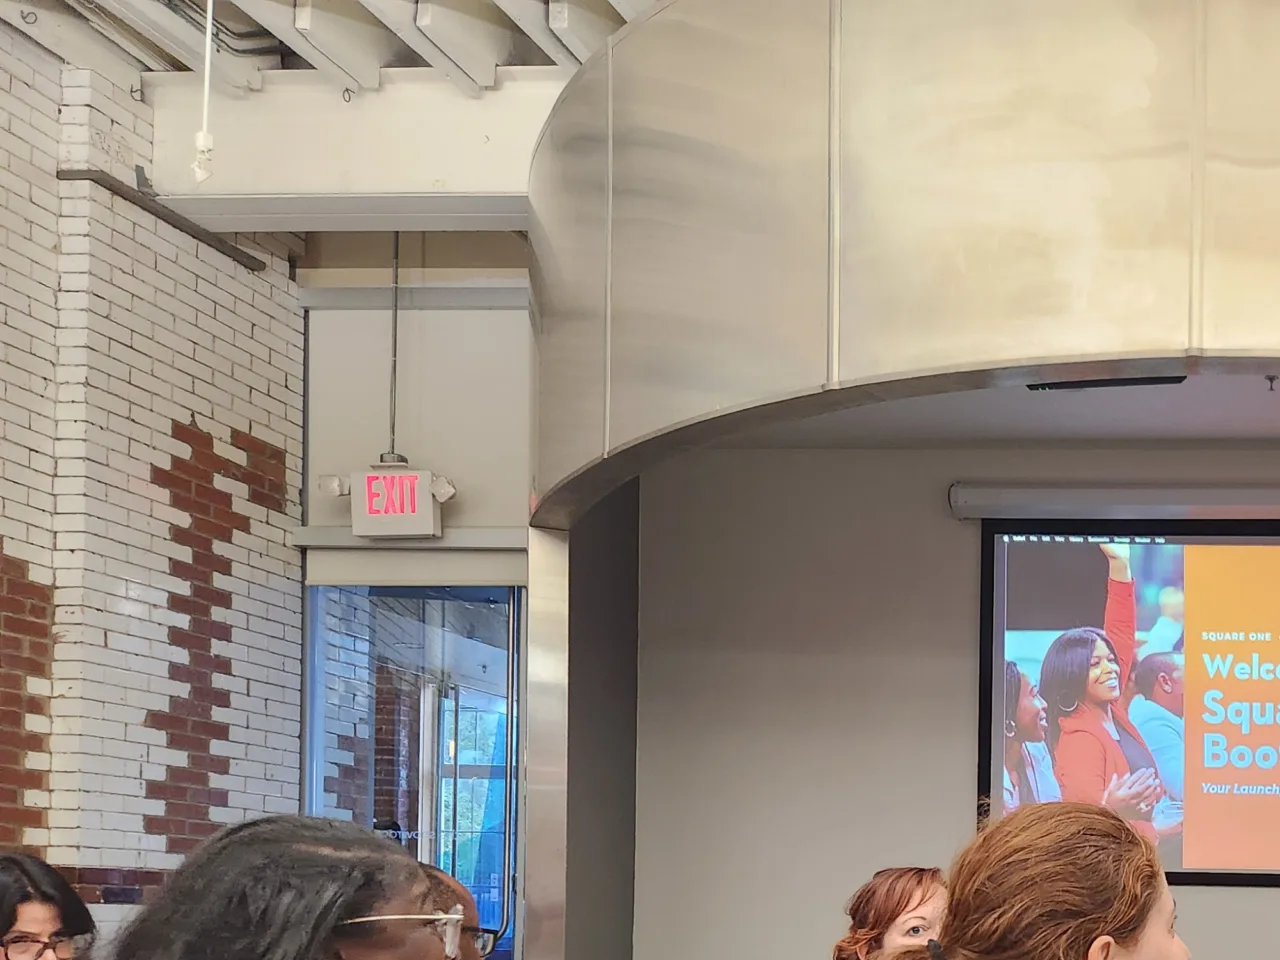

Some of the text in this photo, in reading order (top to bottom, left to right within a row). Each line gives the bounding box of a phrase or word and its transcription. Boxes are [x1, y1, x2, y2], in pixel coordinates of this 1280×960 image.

[366, 475, 418, 514] EXIT
[1201, 632, 1245, 641] SQUARE
[1249, 632, 1272, 641] ONE
[1201, 783, 1231, 795] Your
